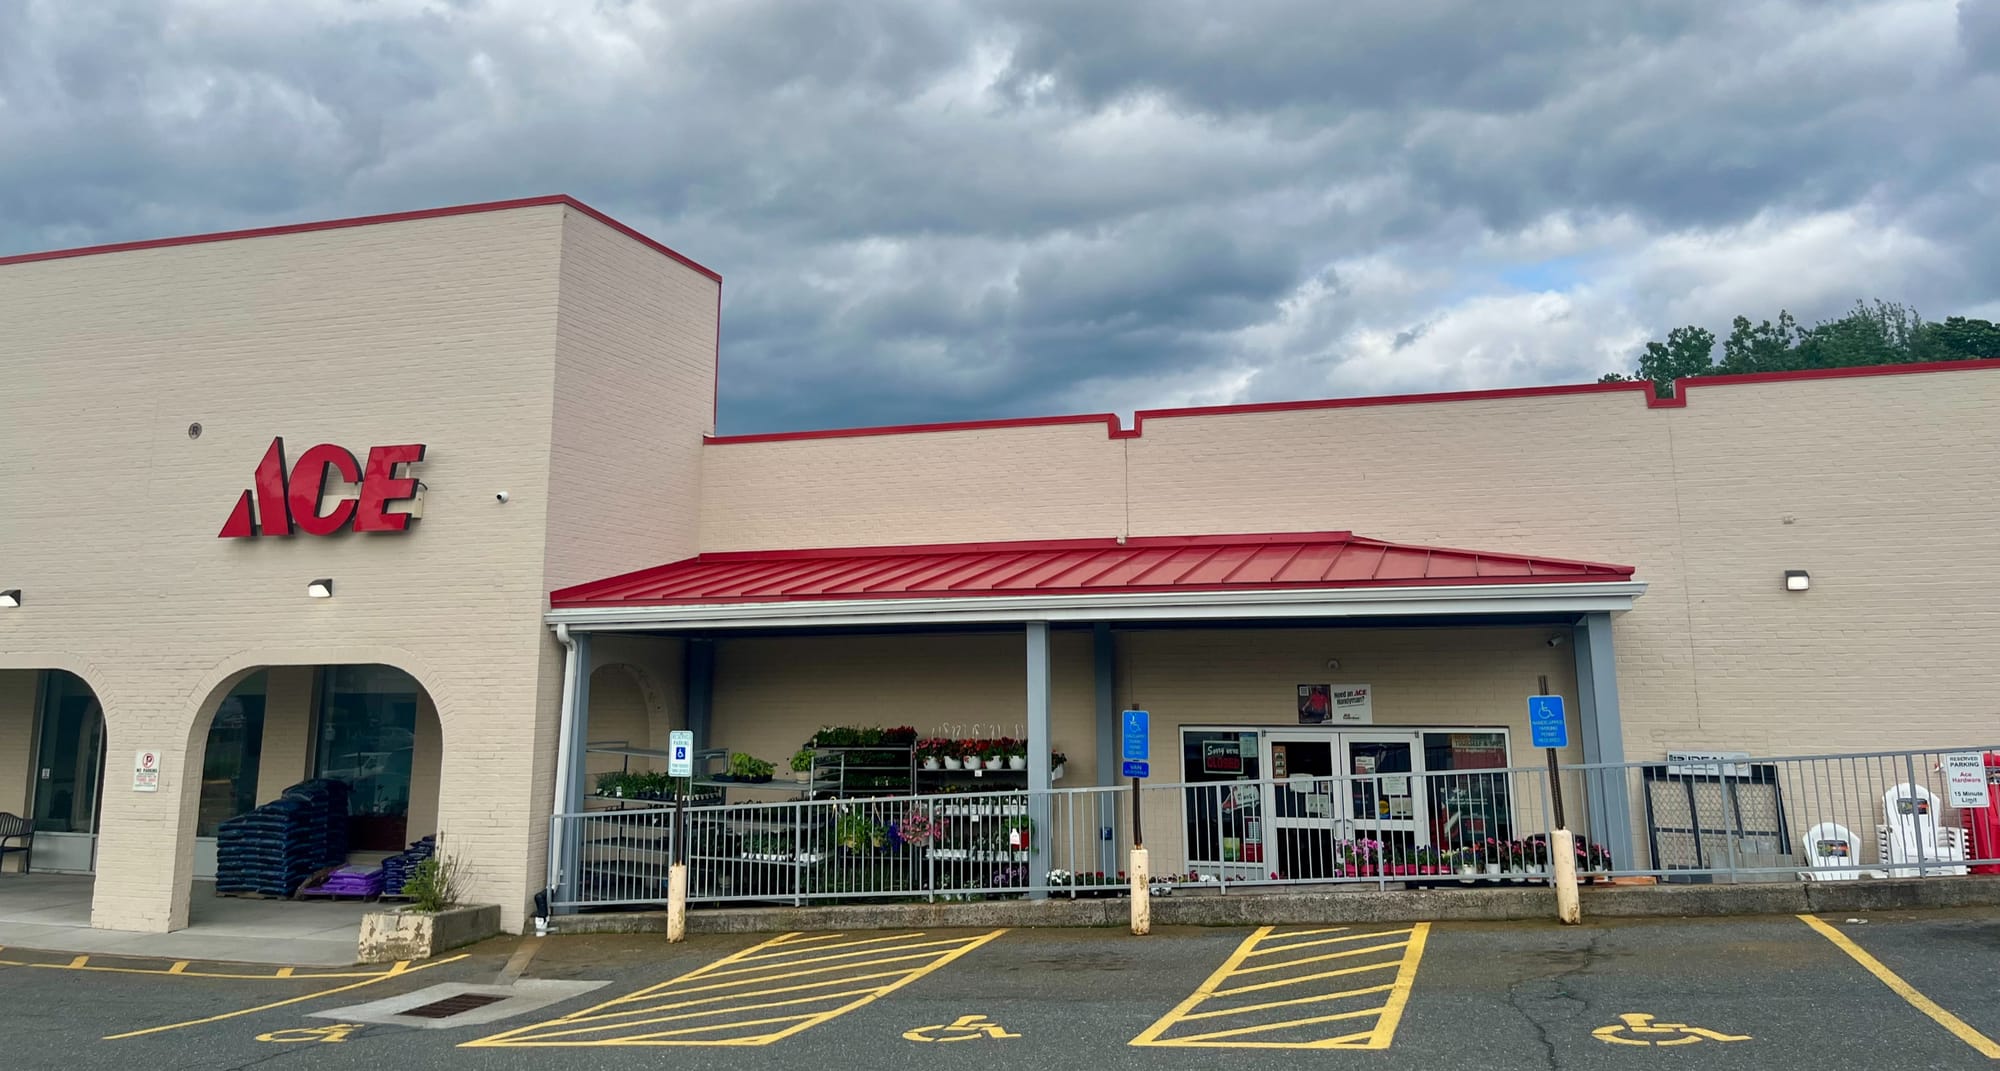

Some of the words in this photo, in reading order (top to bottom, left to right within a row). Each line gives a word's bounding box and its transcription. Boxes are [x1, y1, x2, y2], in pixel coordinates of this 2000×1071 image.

[218, 436, 427, 538] ACE
[1207, 745, 1224, 756] Sorry
[1207, 756, 1240, 769] CLOSED
